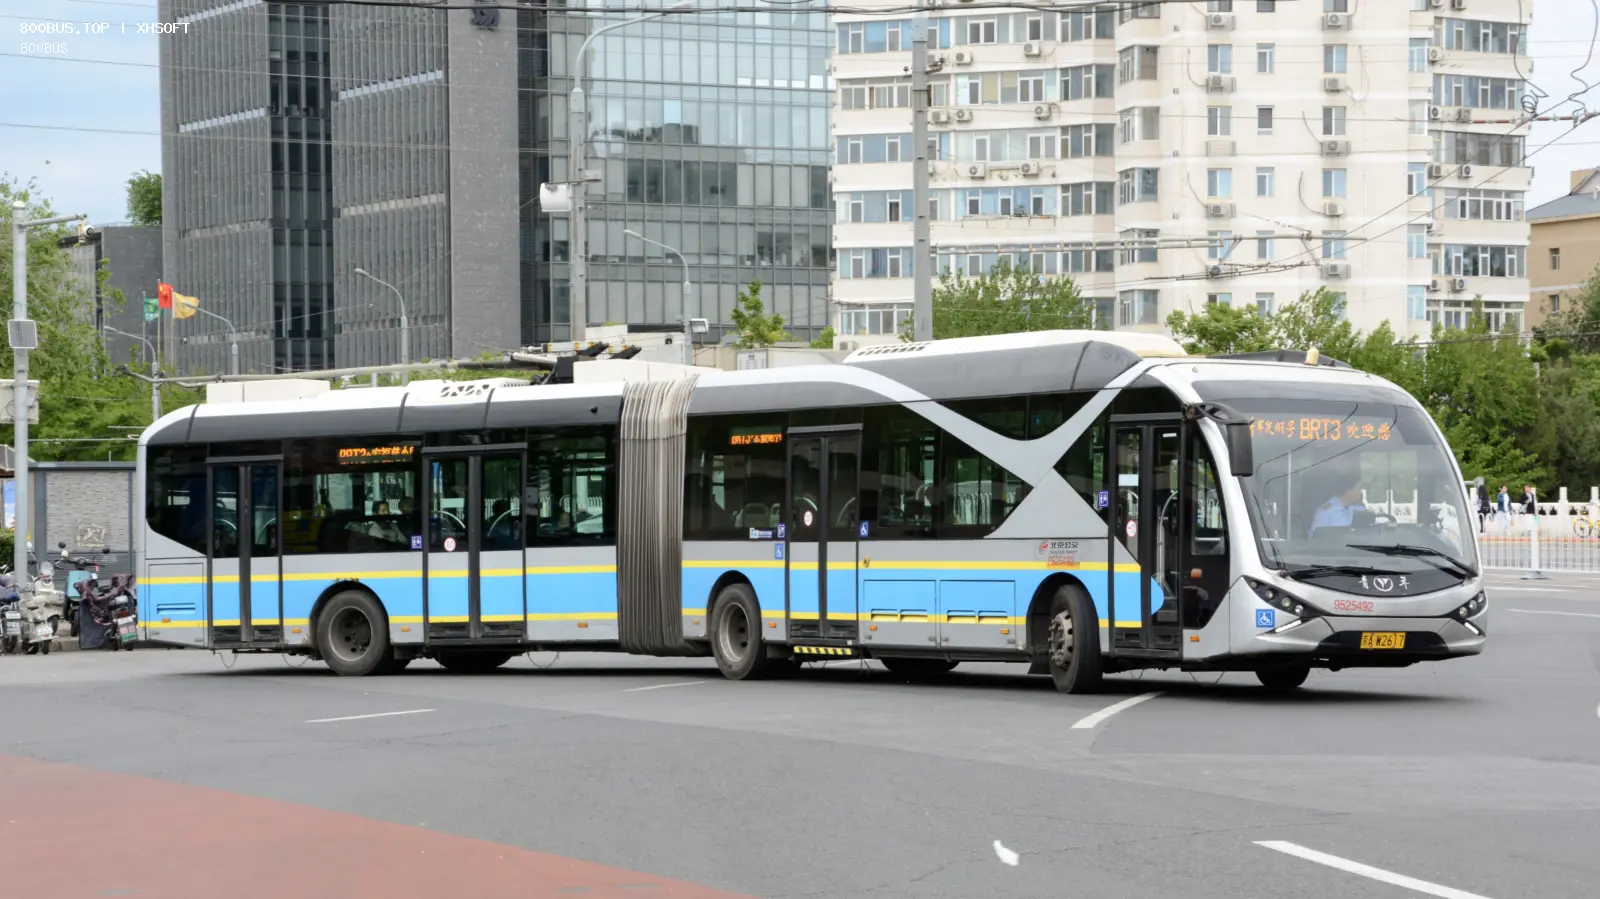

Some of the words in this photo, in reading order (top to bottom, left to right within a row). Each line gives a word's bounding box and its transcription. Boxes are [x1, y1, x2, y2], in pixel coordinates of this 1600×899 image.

[1299, 417, 1341, 441] BRT3
[1050, 541, 1079, 549] 北京公交
[1333, 599, 1375, 612] 9525492
